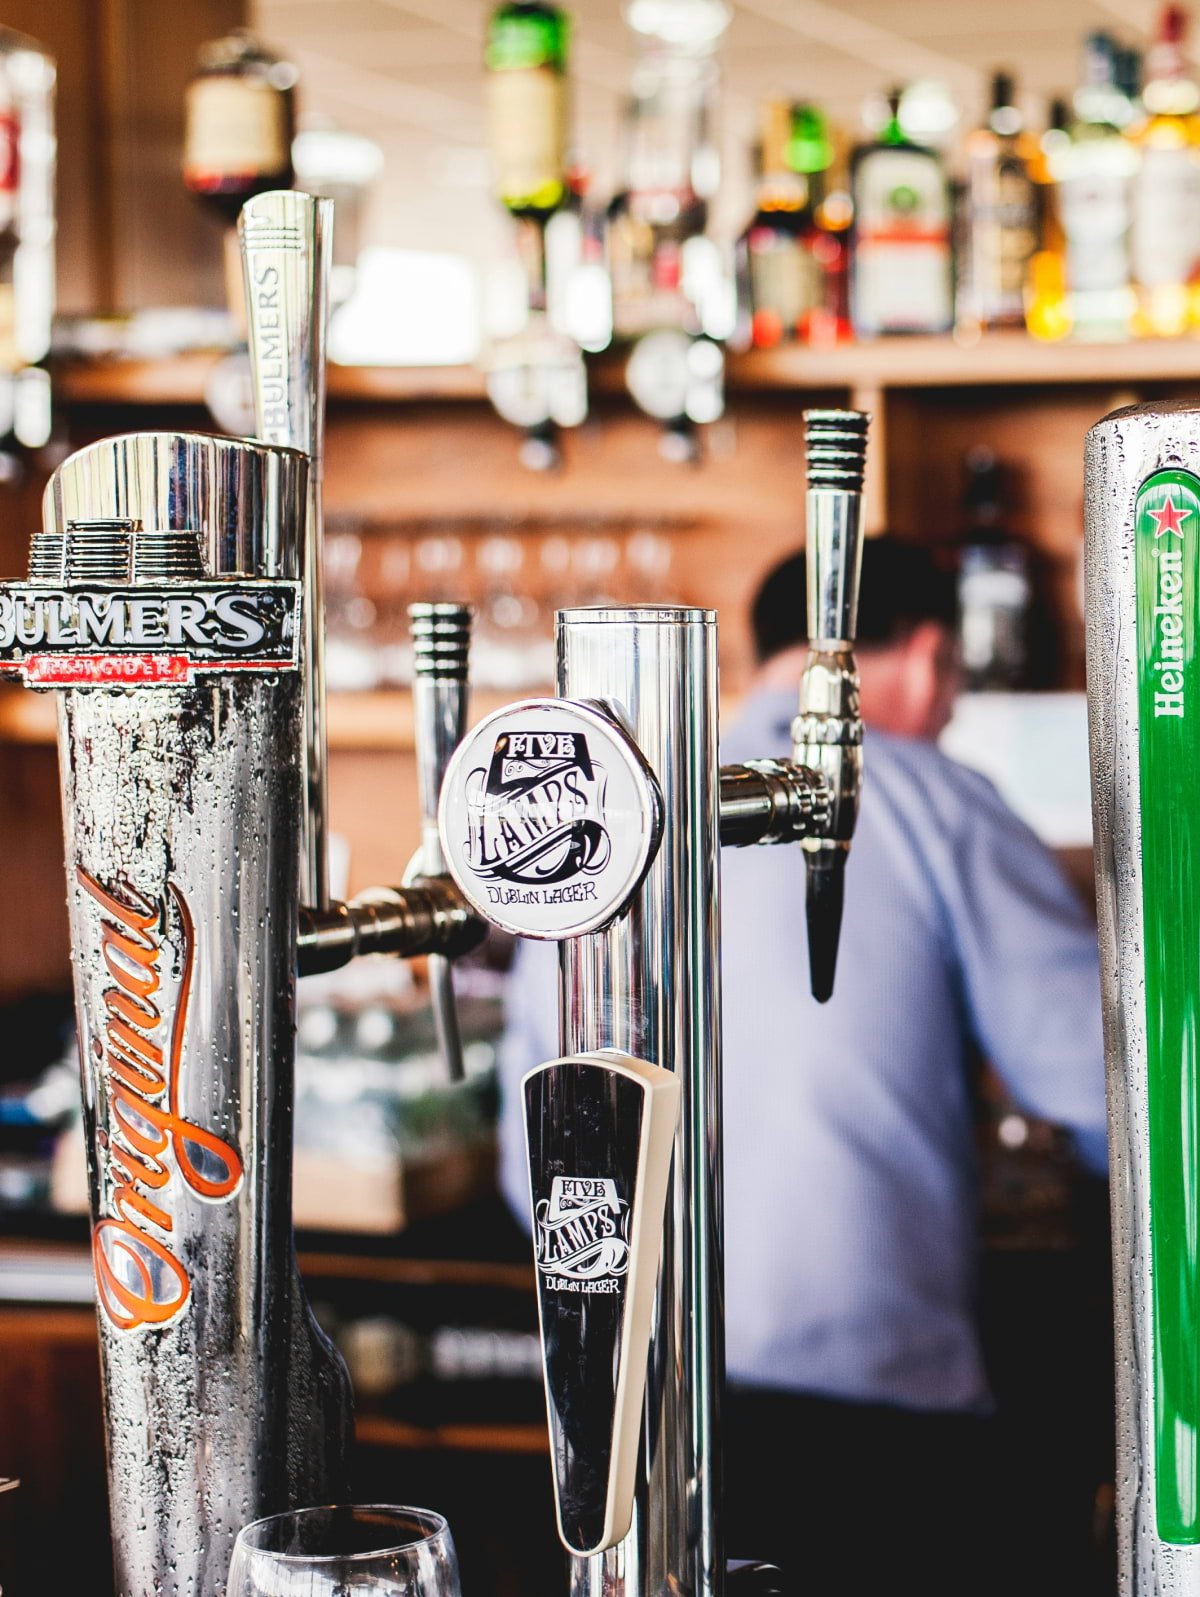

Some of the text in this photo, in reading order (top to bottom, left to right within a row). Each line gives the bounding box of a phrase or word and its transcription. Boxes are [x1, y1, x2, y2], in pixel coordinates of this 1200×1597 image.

[257, 264, 287, 428] BULMERS
[1154, 550, 1184, 718] Heineken
[100, 656, 171, 676] CIDER
[506, 733, 576, 758] FIVE
[485, 881, 599, 905] DUBLIN LAGER
[76, 864, 243, 1329] Original
[561, 1180, 606, 1196] FIVE
[543, 1205, 617, 1263] LAMPS
[545, 1275, 621, 1294] DUBLIN LAGER
